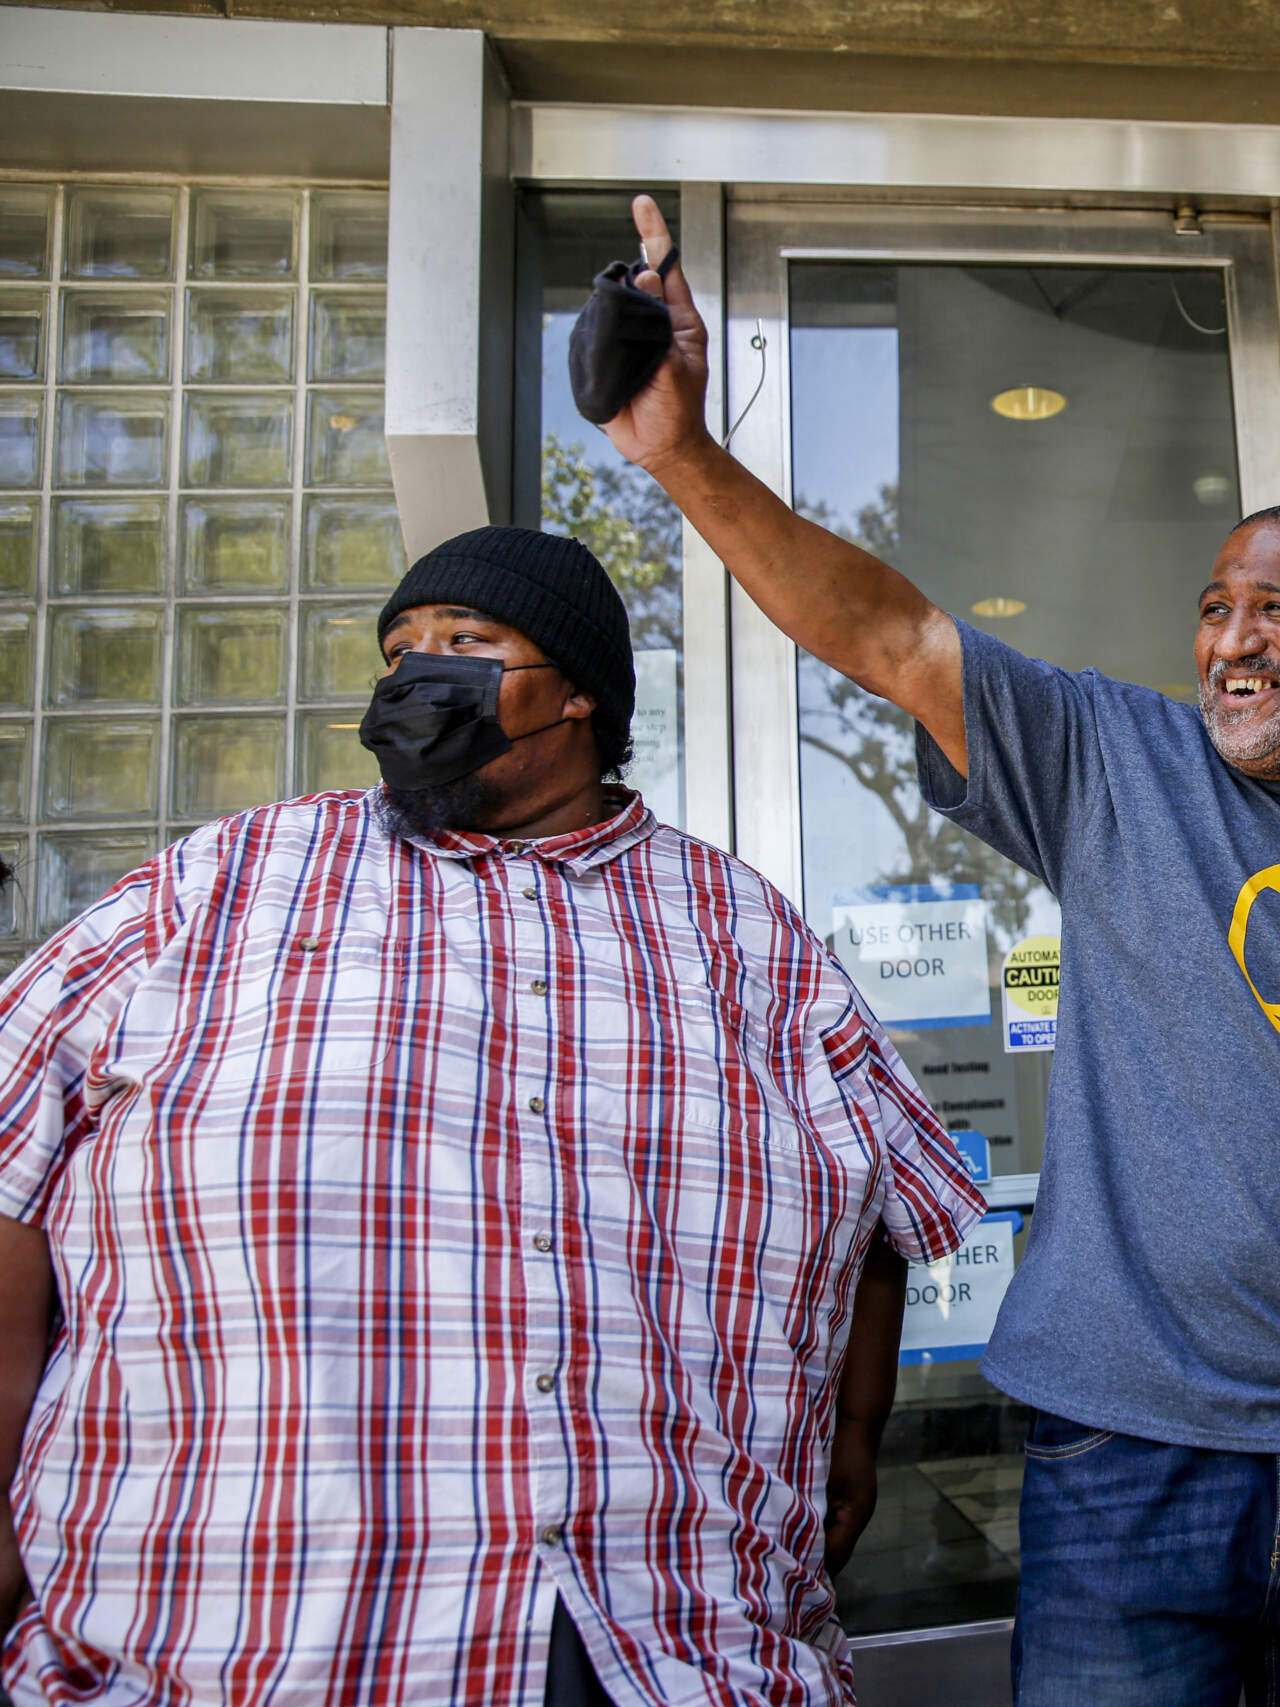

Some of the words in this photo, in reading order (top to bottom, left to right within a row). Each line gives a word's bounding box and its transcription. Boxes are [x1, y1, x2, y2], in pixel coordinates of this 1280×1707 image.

[850, 926, 889, 945] USE
[898, 922, 971, 942] OTHER
[1010, 951, 1061, 963] AUTOMA
[879, 957, 945, 980] DOOR
[1006, 968, 1060, 986] CAUTI
[1010, 1022, 1050, 1034] ACTIVATE
[1021, 1034, 1034, 1045] TO
[906, 1283, 972, 1306] DOOR
